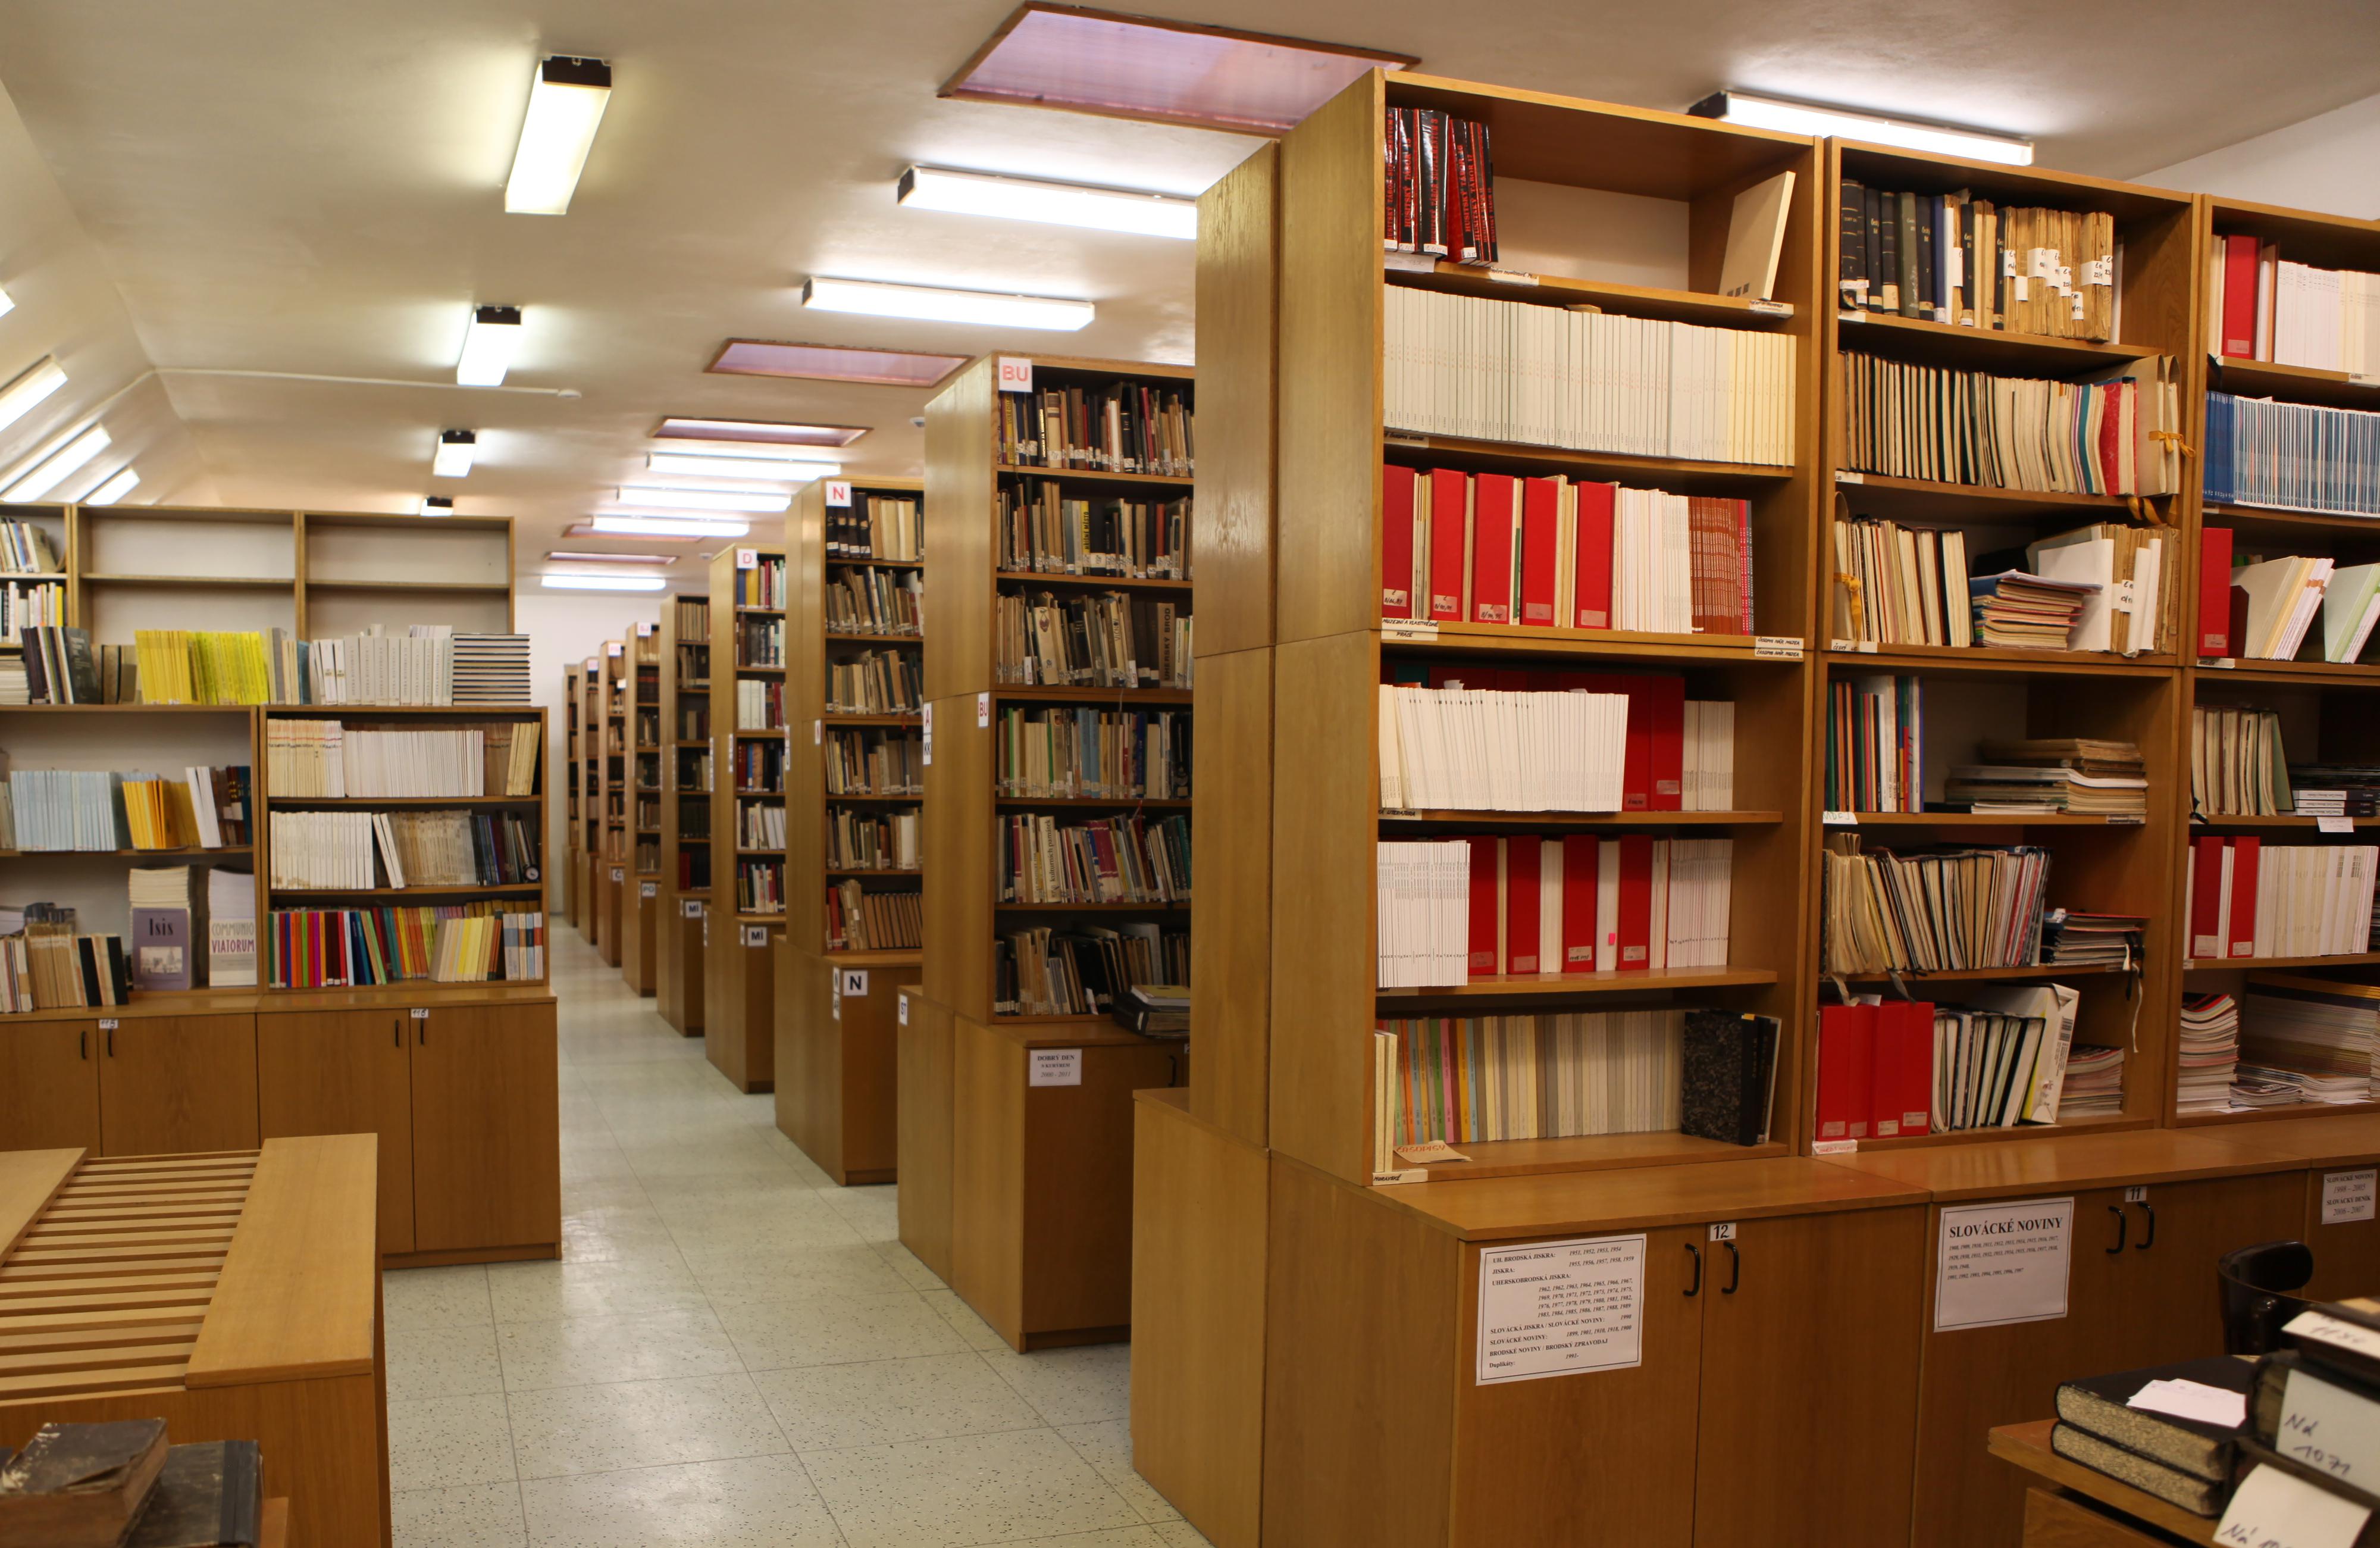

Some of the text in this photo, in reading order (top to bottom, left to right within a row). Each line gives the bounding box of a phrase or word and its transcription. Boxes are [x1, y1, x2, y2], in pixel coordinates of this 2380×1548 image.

[1403, 186, 1411, 227] HUSITSKÝ
[1460, 190, 1471, 232] HUSITSKÝ
[1003, 365, 1028, 381] BU
[833, 486, 844, 500] N
[743, 553, 752, 564] D
[979, 700, 988, 717] BU
[925, 709, 931, 727] A
[149, 918, 173, 936] Isis
[211, 922, 254, 937] COMMUNIO
[211, 939, 255, 953] VIATORUM
[850, 975, 862, 990] N
[2130, 1187, 2141, 1200] 11
[1714, 1225, 1730, 1239] 12
[1949, 1217, 2063, 1238] SLOVÁCKÉ NOVINY
[1504, 1253, 1532, 1262] BRODSKÁ
[1492, 1274, 1548, 1286] UHERSKOBRODSKÁ
[1490, 1325, 1523, 1334] SLOVÁCKÁ
[1548, 1318, 1580, 1328] SLOVÁCKÉ
[1489, 1347, 1517, 1356] BRODSKÉ
[1518, 1346, 1541, 1354] NOVINY
[1545, 1341, 1573, 1350] BRODSKÝ
[1574, 1338, 1608, 1347] ZPRAVODAJ
[1490, 1336, 1521, 1345] SLOVÁCKÉ
[1489, 1361, 1516, 1369] Duplikáty:
[2293, 1445, 2351, 1476] 1071
